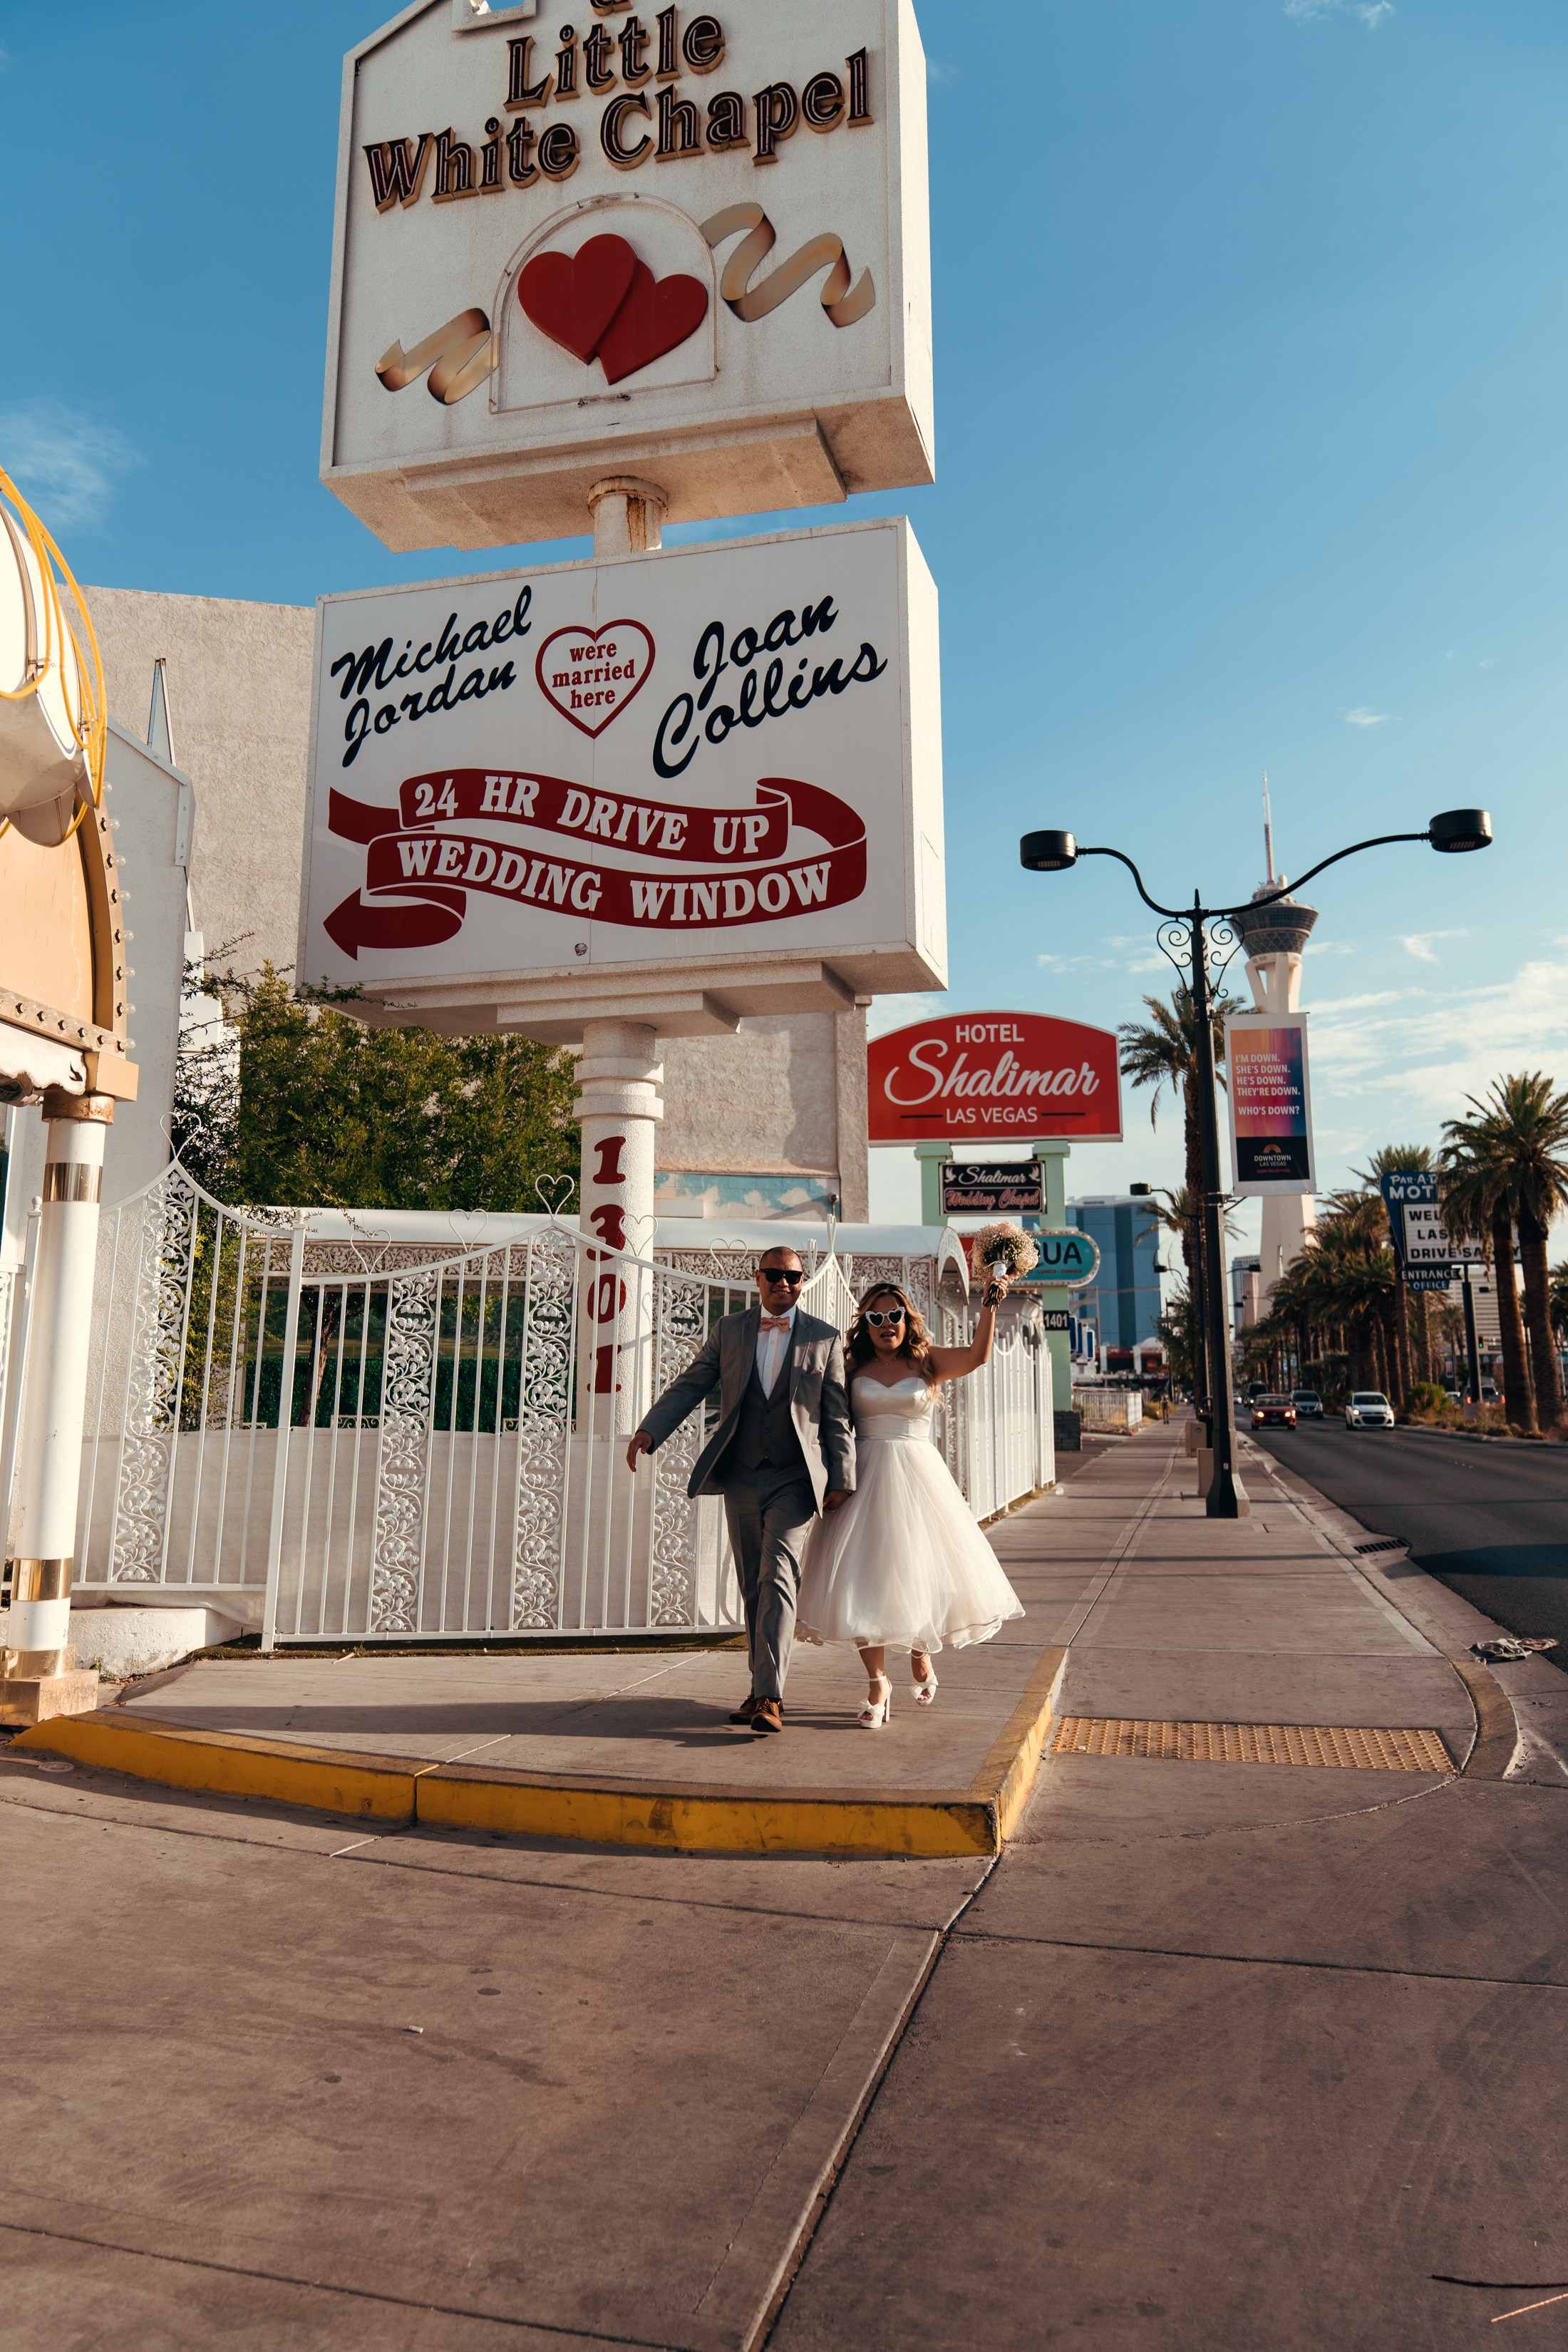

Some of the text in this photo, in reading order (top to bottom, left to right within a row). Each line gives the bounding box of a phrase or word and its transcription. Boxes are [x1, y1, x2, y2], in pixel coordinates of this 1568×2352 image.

[502, 3, 726, 112] Little
[361, 46, 874, 214] White Chapel
[330, 584, 532, 700] Michael
[569, 641, 618, 663] were
[693, 594, 839, 709] Joan
[552, 658, 636, 688] married
[569, 686, 617, 710] here
[341, 660, 517, 768] Jordan
[652, 641, 888, 779] Collins
[414, 775, 770, 855] 24 HR DRIVE UP
[397, 840, 832, 922] WEDDING WINDOW
[956, 1023, 1025, 1043] HOTEL
[1235, 1053, 1281, 1063] I'M DOWN.
[884, 1038, 1100, 1105] Shalimar
[1236, 1064, 1291, 1074] SHE'S DOWN.
[1237, 1076, 1286, 1085] HE'S DOWN.
[1237, 1086, 1301, 1096] THEY'RE DOWN.
[946, 1106, 1038, 1124] LAS VEGAS
[1238, 1105, 1300, 1115] WHO'S DOWN?
[959, 1166, 1026, 1185] Shalimar
[946, 1188, 1039, 1210] Wedding Chapel
[1389, 1185, 1434, 1200] MOT
[1417, 1229, 1448, 1240] LAS
[1410, 1247, 1458, 1259] DRIVE
[586, 1136, 627, 1393] 1301
[1401, 1268, 1458, 1281] ENTRANCE
[1413, 1281, 1448, 1291] OFFICE
[1044, 1314, 1068, 1328] 1401
